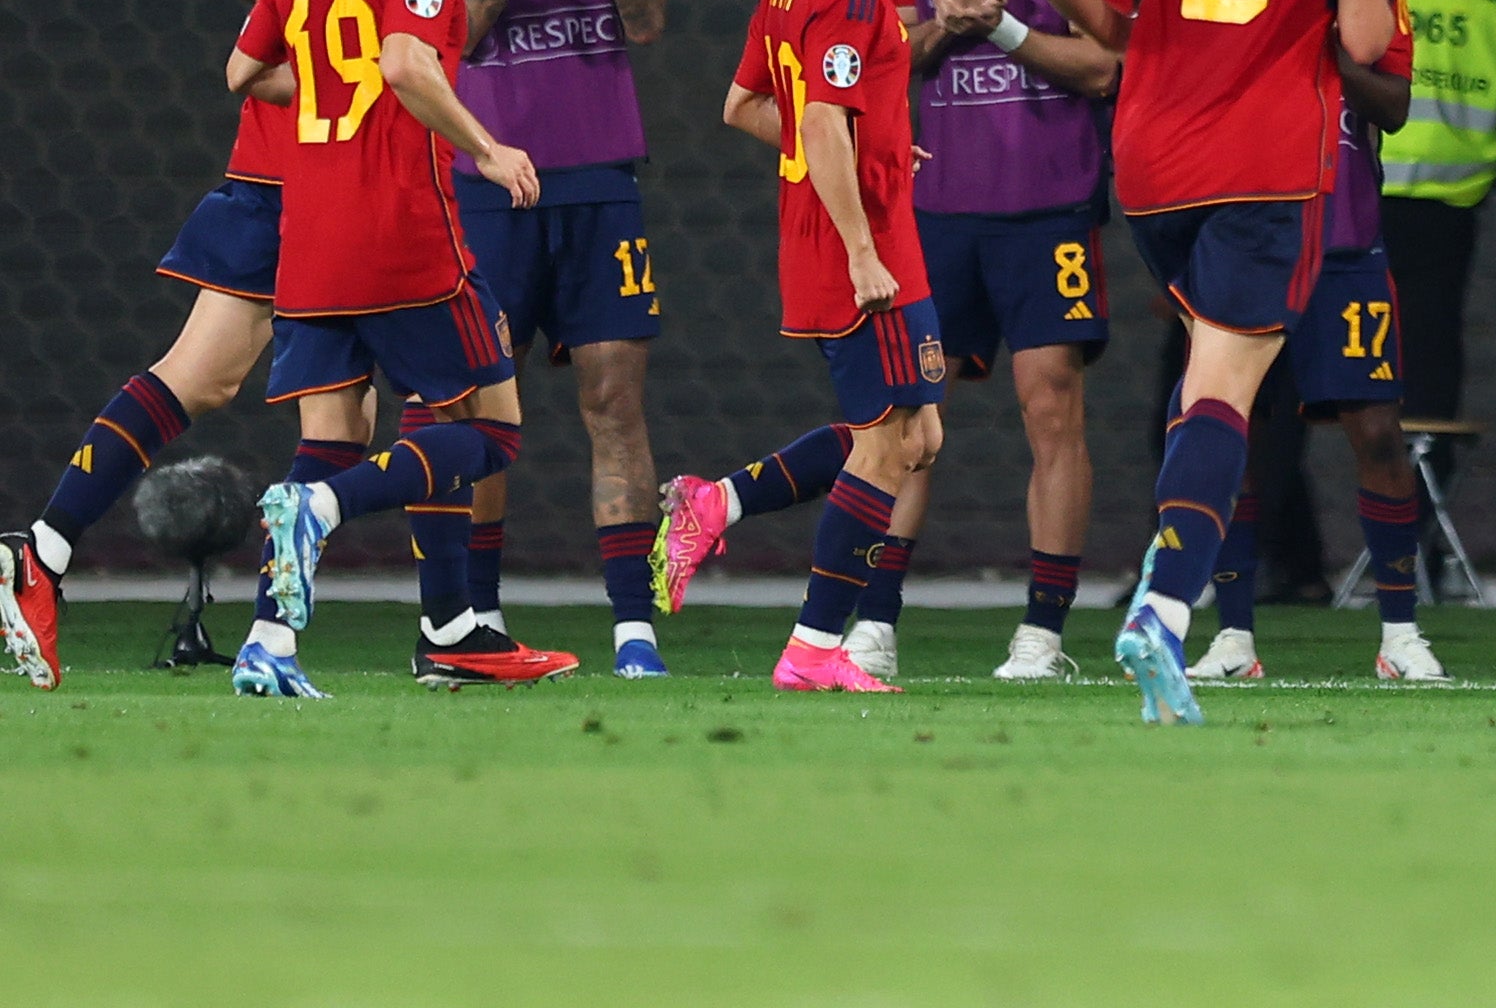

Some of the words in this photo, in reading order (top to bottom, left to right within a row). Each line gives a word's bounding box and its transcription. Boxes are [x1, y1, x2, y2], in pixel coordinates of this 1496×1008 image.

[951, 63, 1050, 95] RESP
[1054, 242, 1090, 298] 8
[1341, 300, 1391, 358] 17
